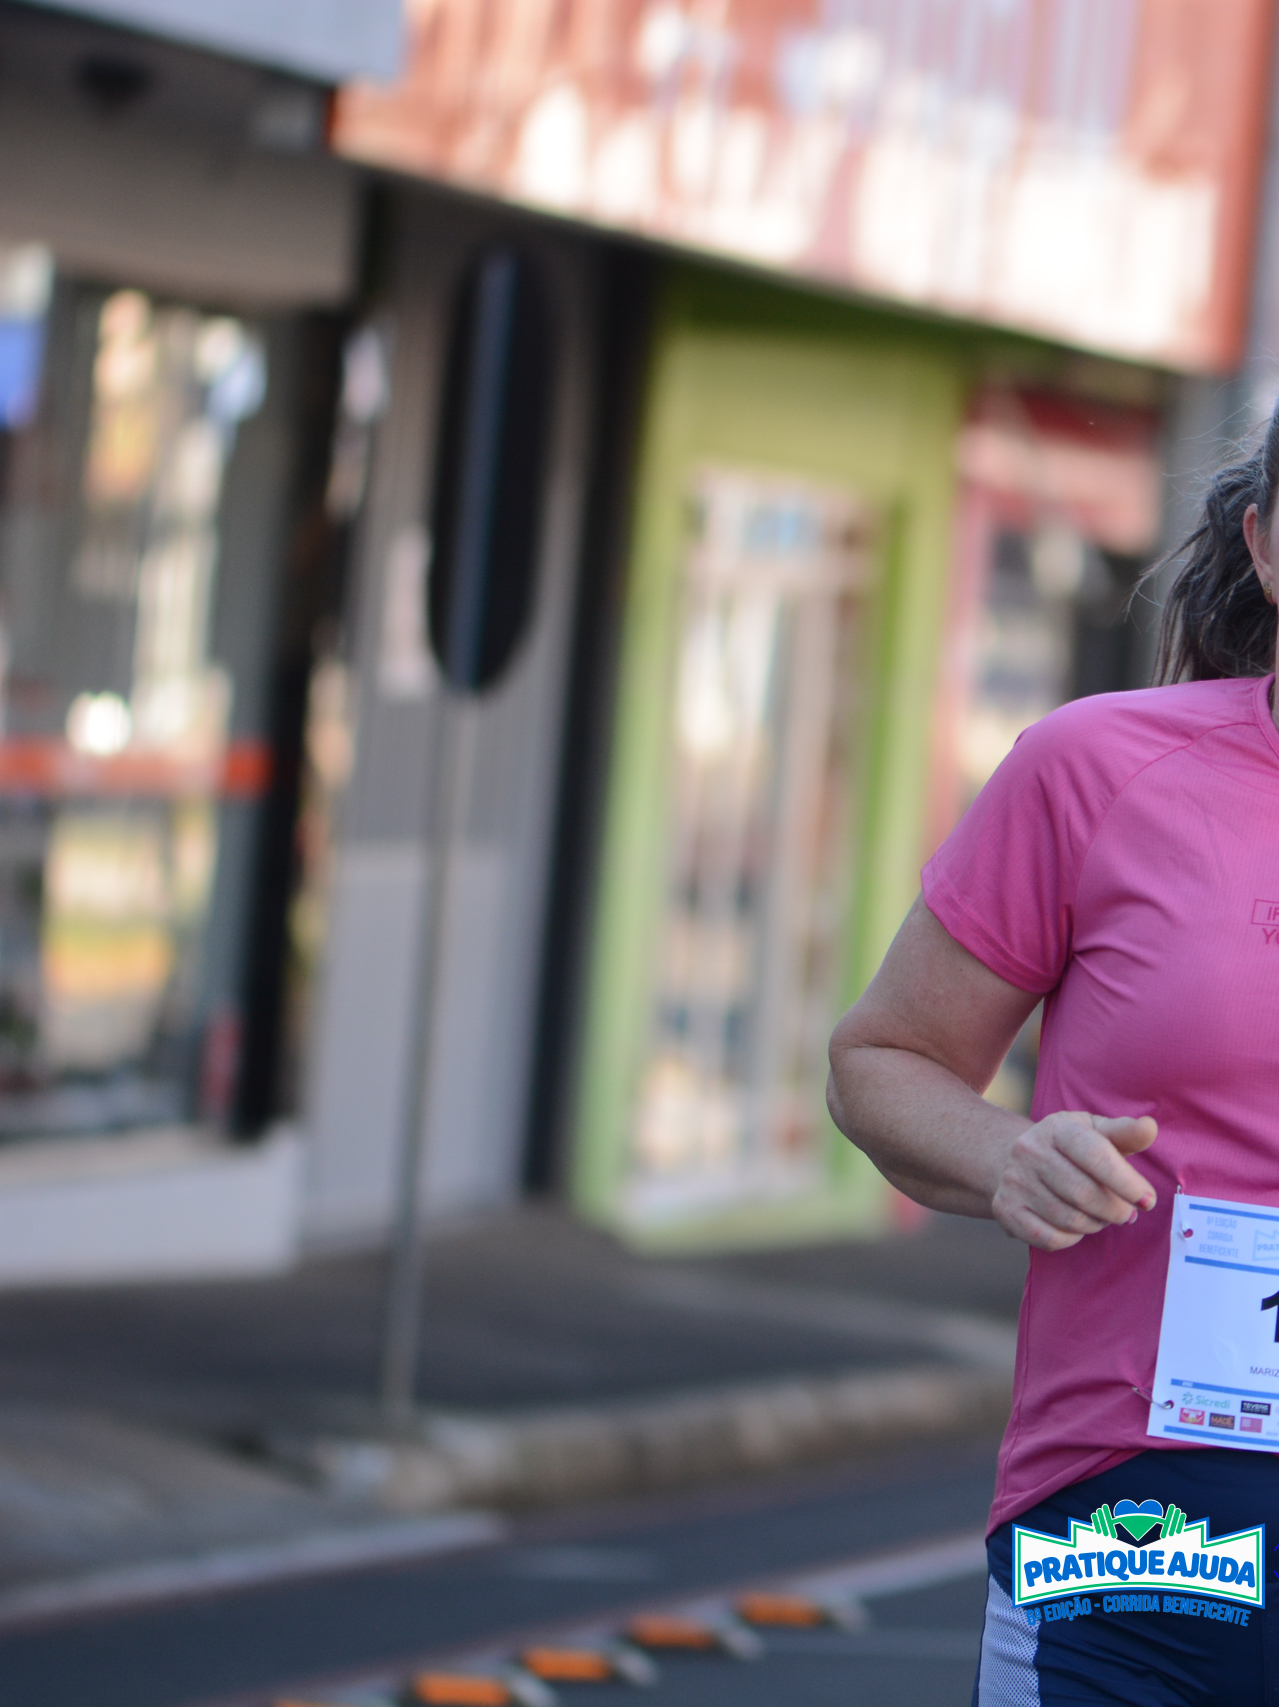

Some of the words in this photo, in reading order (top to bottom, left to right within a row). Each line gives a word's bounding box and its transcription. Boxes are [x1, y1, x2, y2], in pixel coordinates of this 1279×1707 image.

[1207, 1230, 1234, 1243] CORRIDA
[1198, 1243, 1240, 1258] BENEFICENTE
[1195, 1395, 1231, 1409] Sicredi
